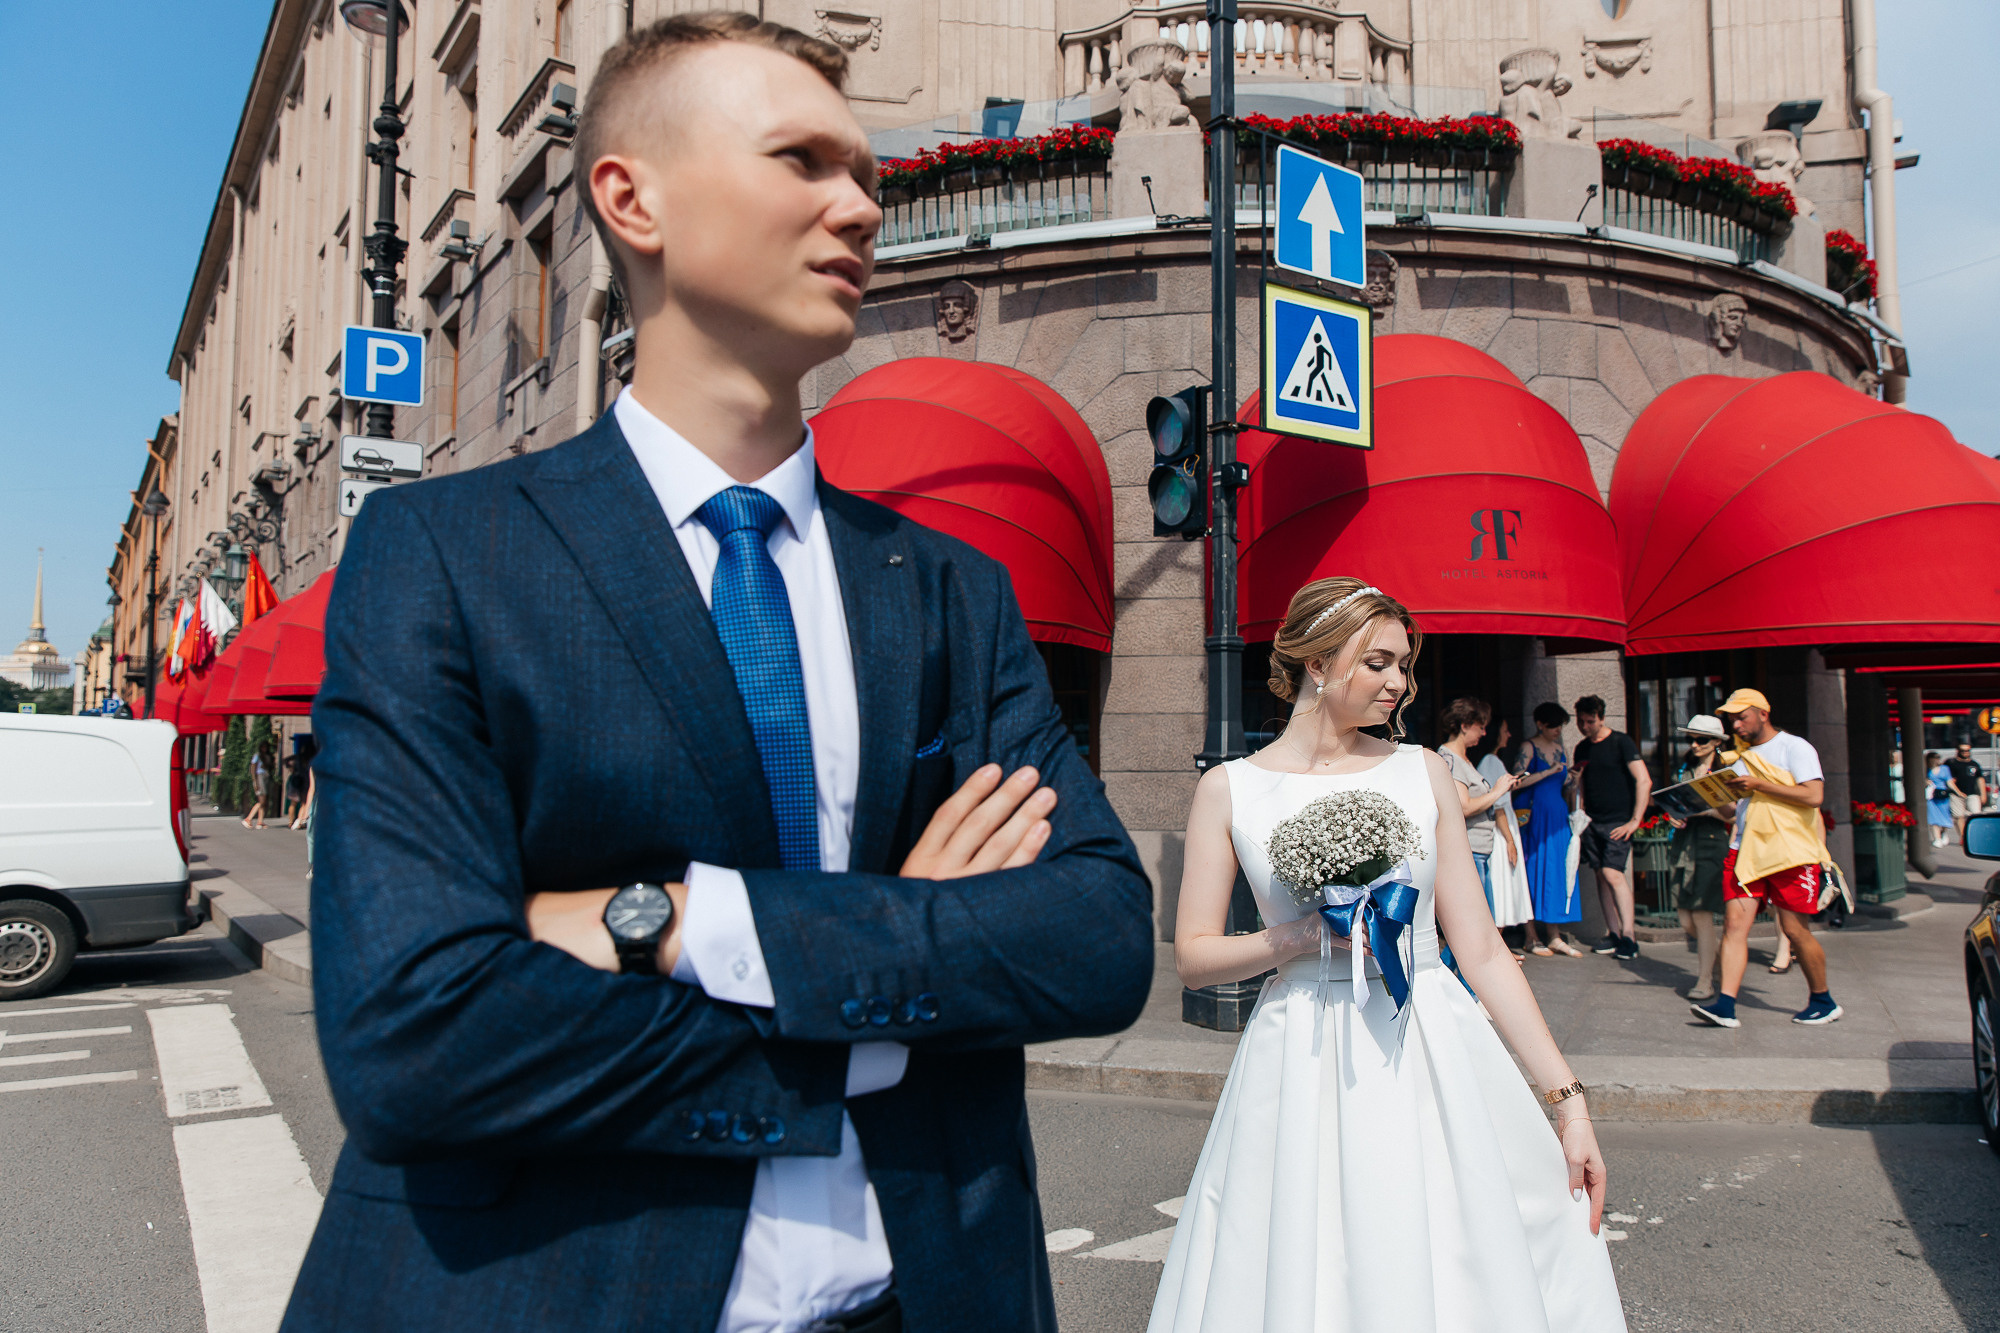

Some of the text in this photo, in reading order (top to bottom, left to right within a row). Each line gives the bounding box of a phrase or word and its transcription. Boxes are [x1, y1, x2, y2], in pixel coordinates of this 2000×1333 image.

[366, 337, 409, 393] P
[1441, 568, 1549, 581] HOTEL ASTORIA
[106, 700, 118, 713] P
